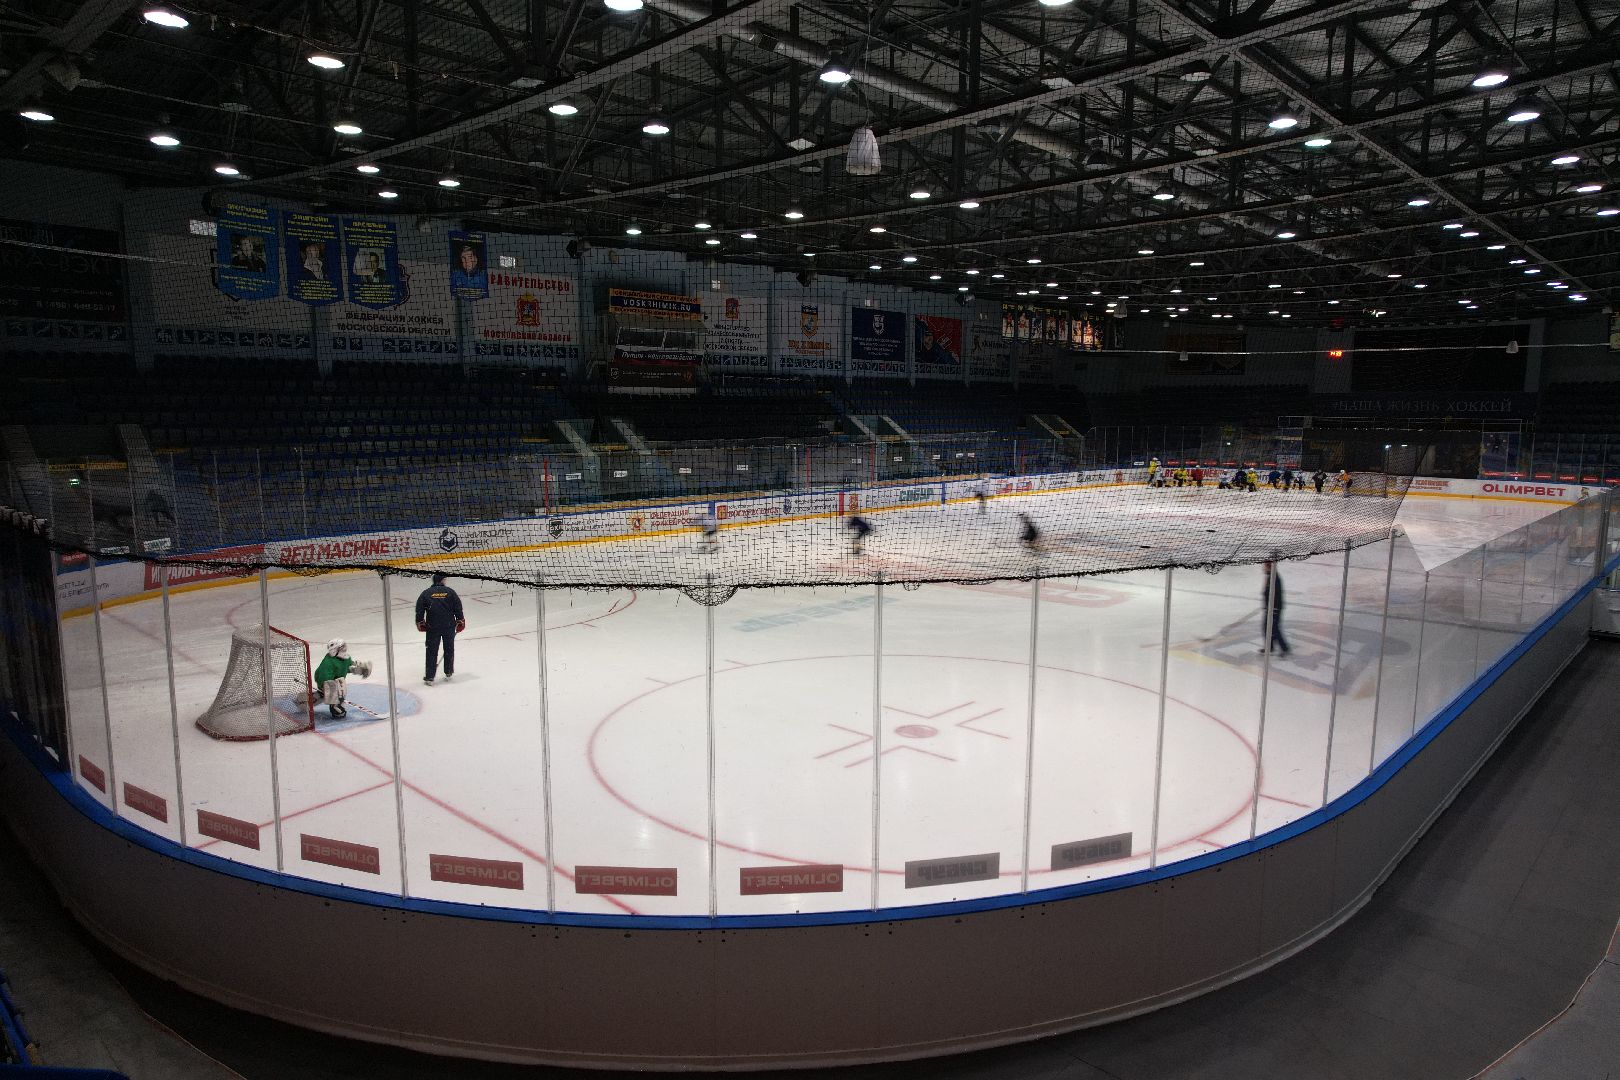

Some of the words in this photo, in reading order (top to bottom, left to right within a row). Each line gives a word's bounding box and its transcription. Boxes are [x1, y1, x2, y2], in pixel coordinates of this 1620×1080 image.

[490, 272, 570, 291] РАВИТЕЛЬСТВО
[346, 312, 405, 323] ФЕДЕРАЦИЯ
[408, 315, 443, 325] ХОККЕЯ
[337, 323, 406, 333] МОСКОВСКОЙ
[408, 326, 451, 335] ОБЛАСТИ
[483, 328, 537, 340] МОСКОВСКОЙ
[538, 331, 571, 342] ОБЛАСТИ
[1447, 398, 1511, 412] ХОККЕЙ
[1482, 483, 1566, 497] OLIMPBET
[317, 537, 391, 561] MACHINE
